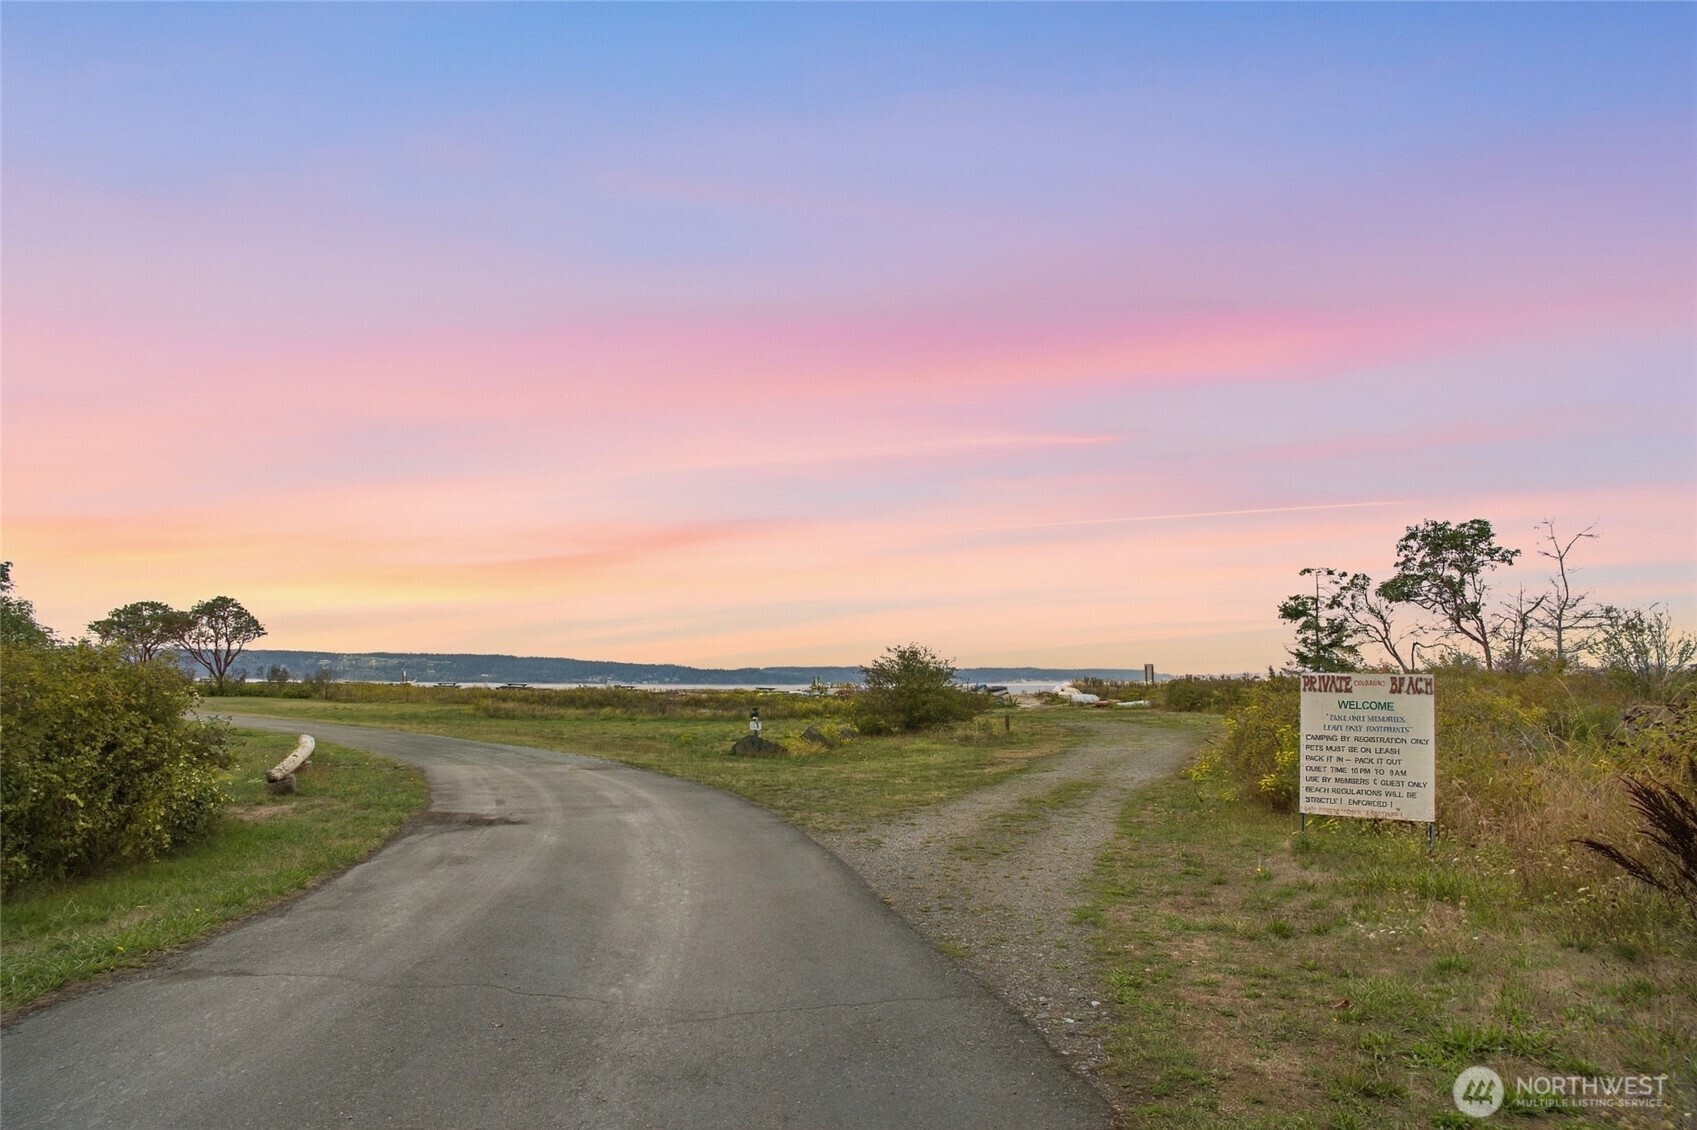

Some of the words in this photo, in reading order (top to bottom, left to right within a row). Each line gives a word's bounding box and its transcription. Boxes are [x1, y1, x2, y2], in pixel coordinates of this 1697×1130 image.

[1302, 676, 1352, 693] PRIVATE
[1390, 676, 1433, 695] BEACH
[1338, 700, 1394, 711] WELCOME
[1306, 734, 1338, 742] CAMPING
[1354, 736, 1407, 744] REGISTRATION
[1380, 779, 1405, 787] GUEST
[1332, 788, 1382, 796] REGULATIONS
